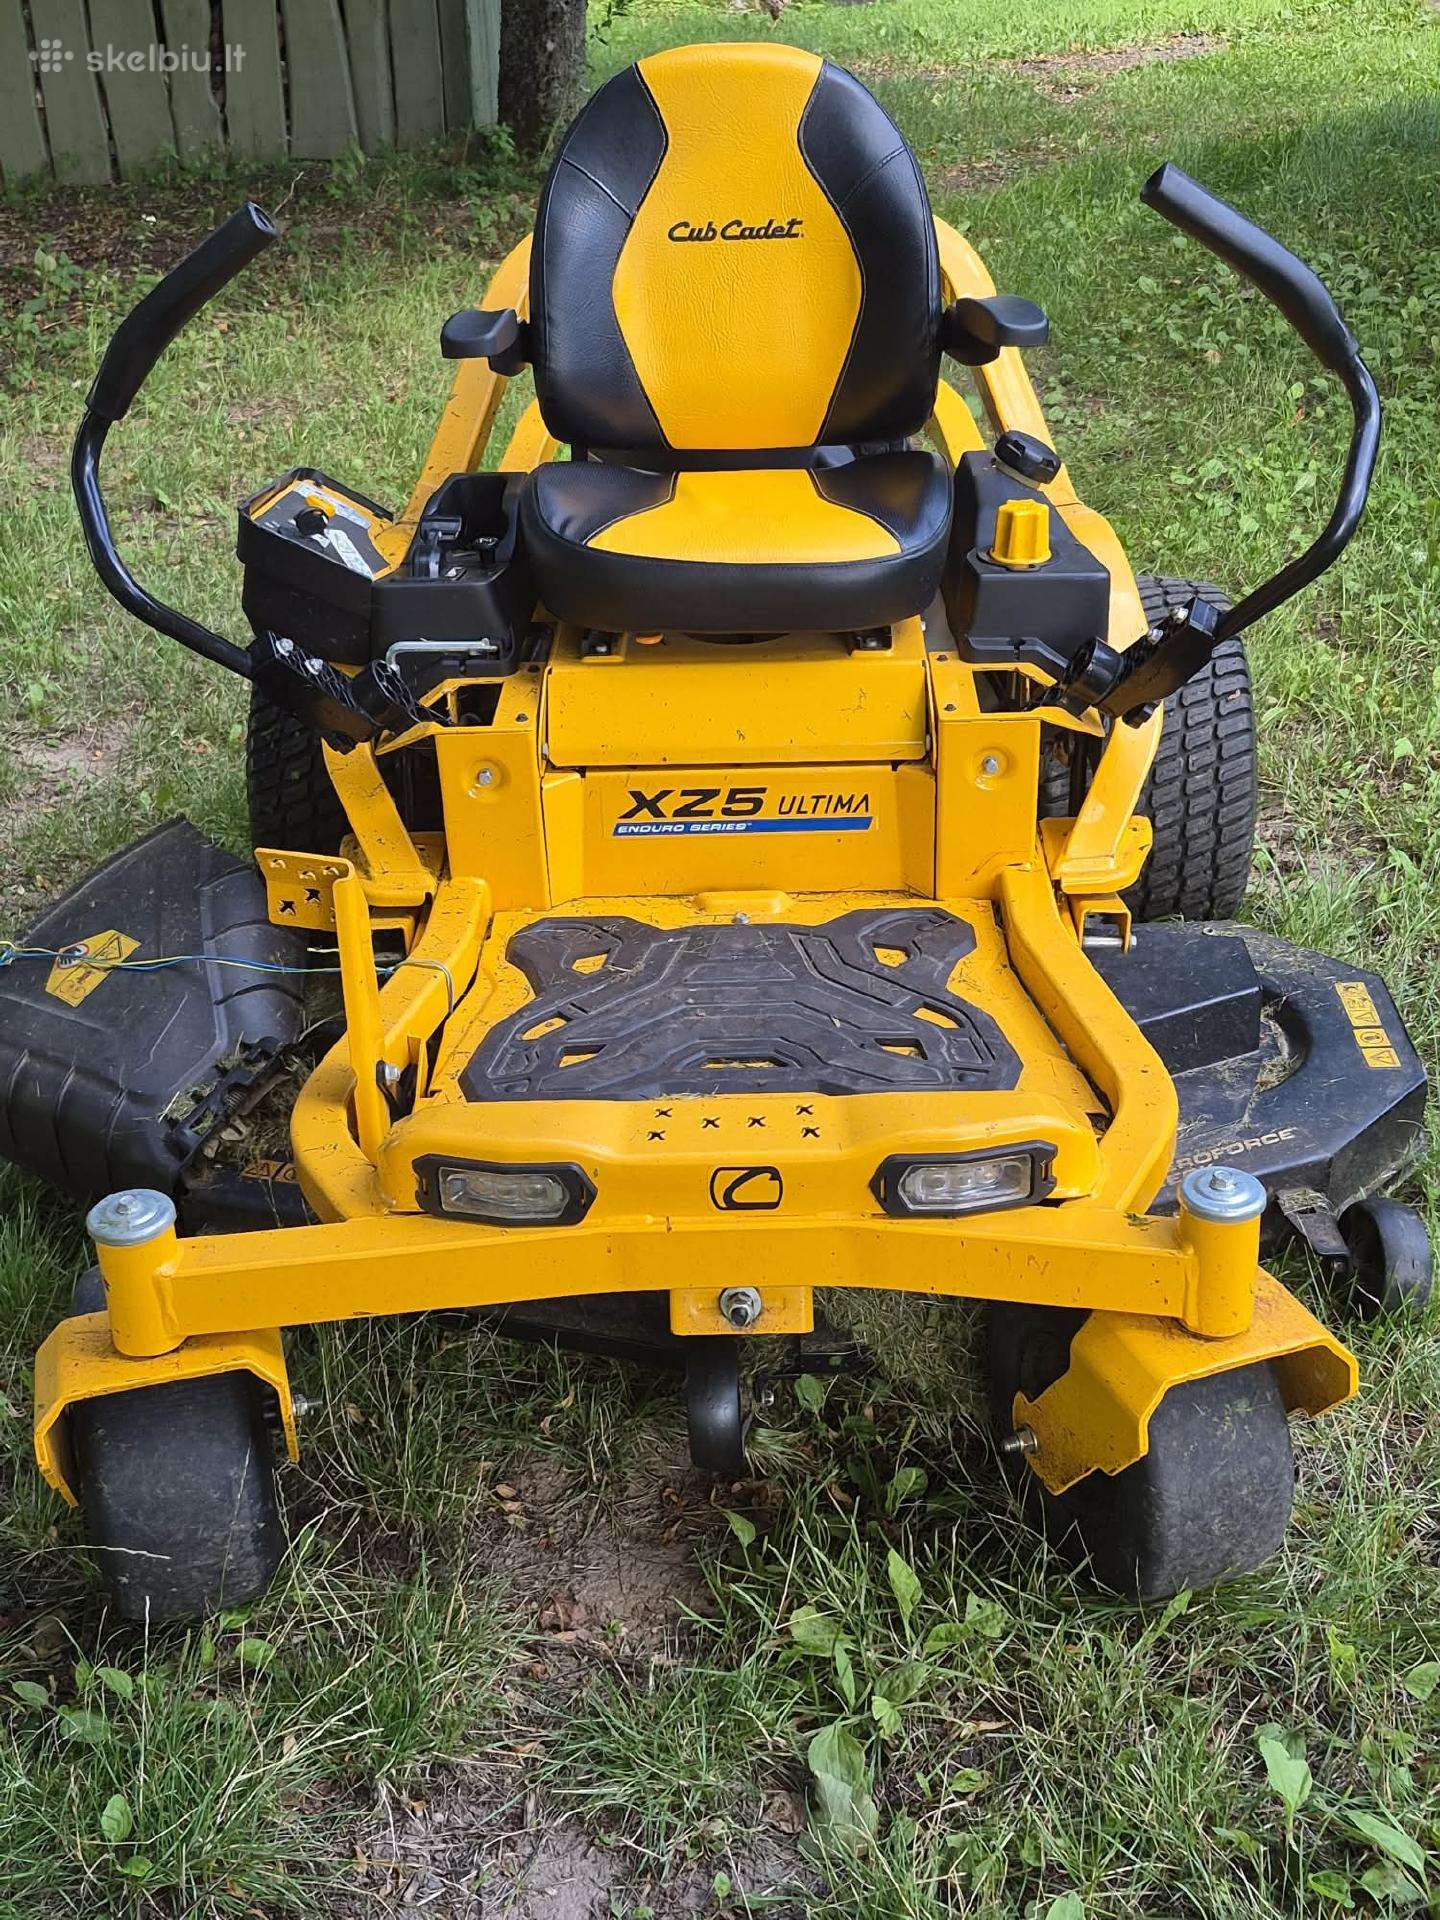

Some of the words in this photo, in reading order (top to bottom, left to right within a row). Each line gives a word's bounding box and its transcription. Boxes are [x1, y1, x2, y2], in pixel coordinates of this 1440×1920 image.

[667, 220, 718, 243] Cub
[720, 217, 803, 241] Cadet
[617, 786, 768, 819] XZ5
[777, 793, 870, 816] ULTIMA
[617, 823, 685, 834] ENDURO
[1174, 1127, 1297, 1171] ROFORCE
